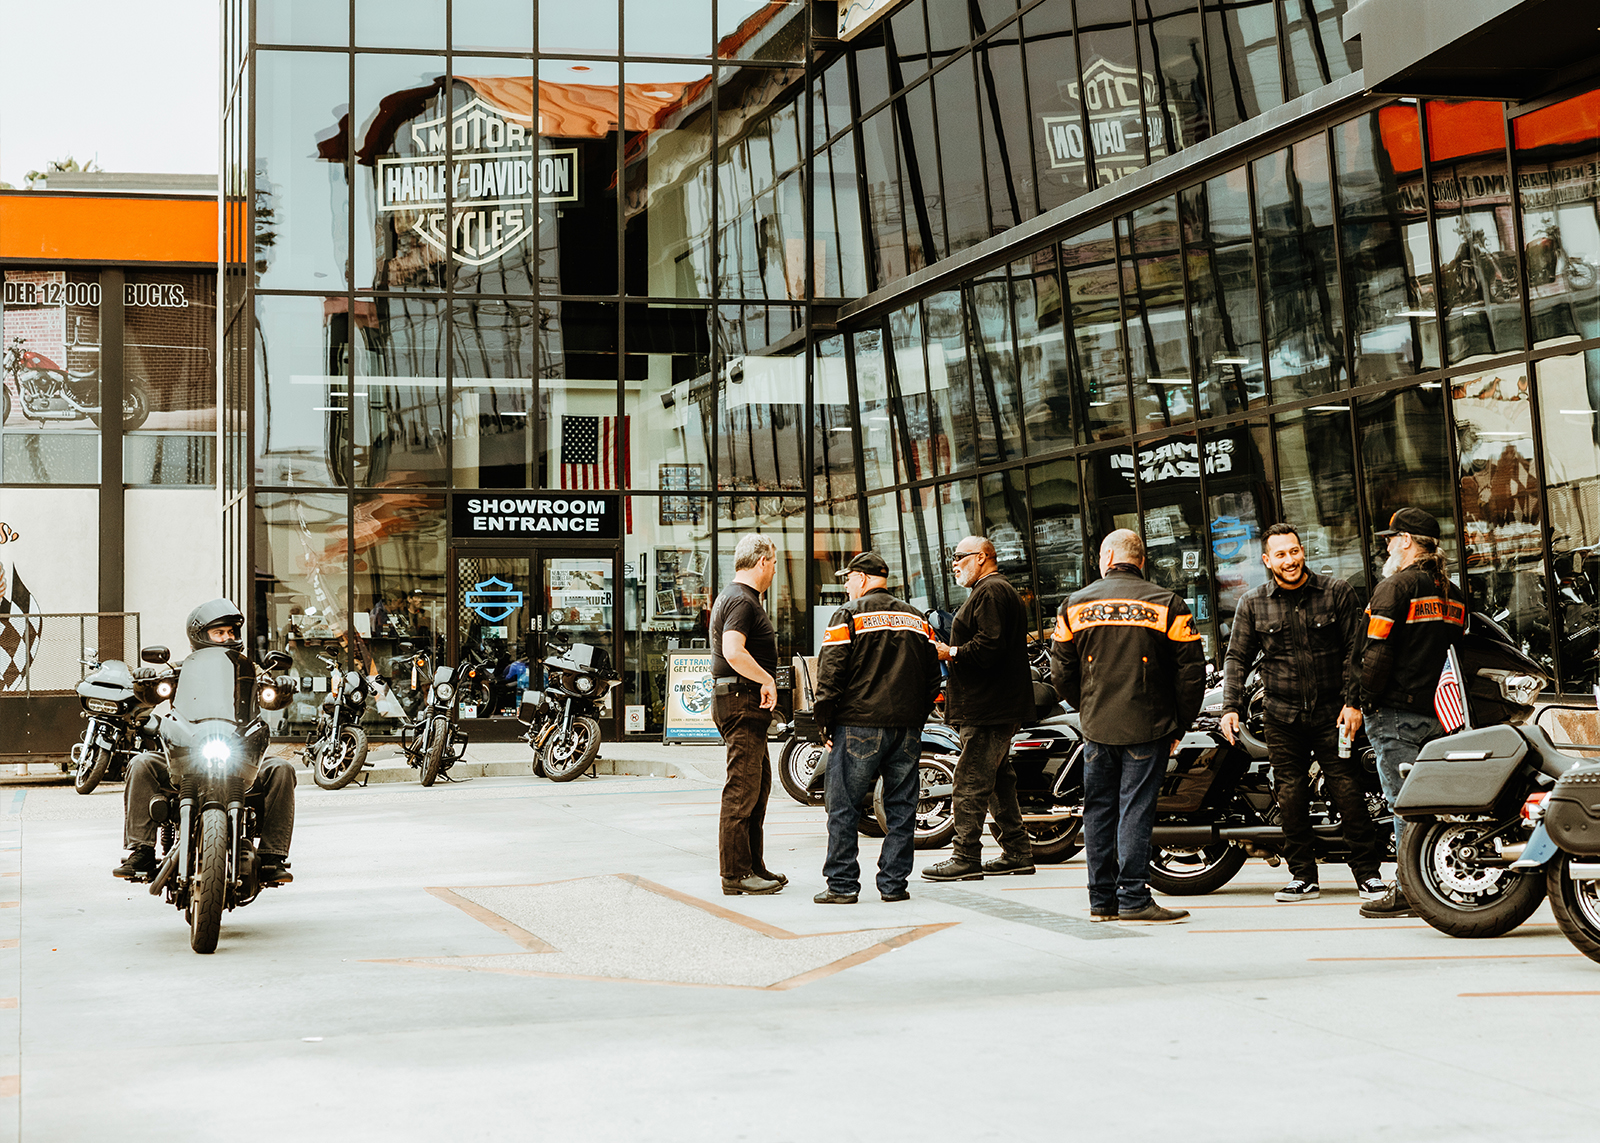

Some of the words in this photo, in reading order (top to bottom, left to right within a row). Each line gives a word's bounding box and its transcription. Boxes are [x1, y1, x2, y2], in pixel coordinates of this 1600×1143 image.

[430, 109, 525, 151] MOTOR
[387, 157, 569, 201] HARLEY-DAVIDSON
[430, 209, 524, 257] CYCLES
[4, 282, 37, 304] DER
[41, 282, 102, 307] 12,000
[123, 283, 188, 307] BUCKS.
[467, 499, 605, 515] SHOWROOM
[473, 516, 600, 532] ENTRANCE
[674, 658, 688, 666] GET
